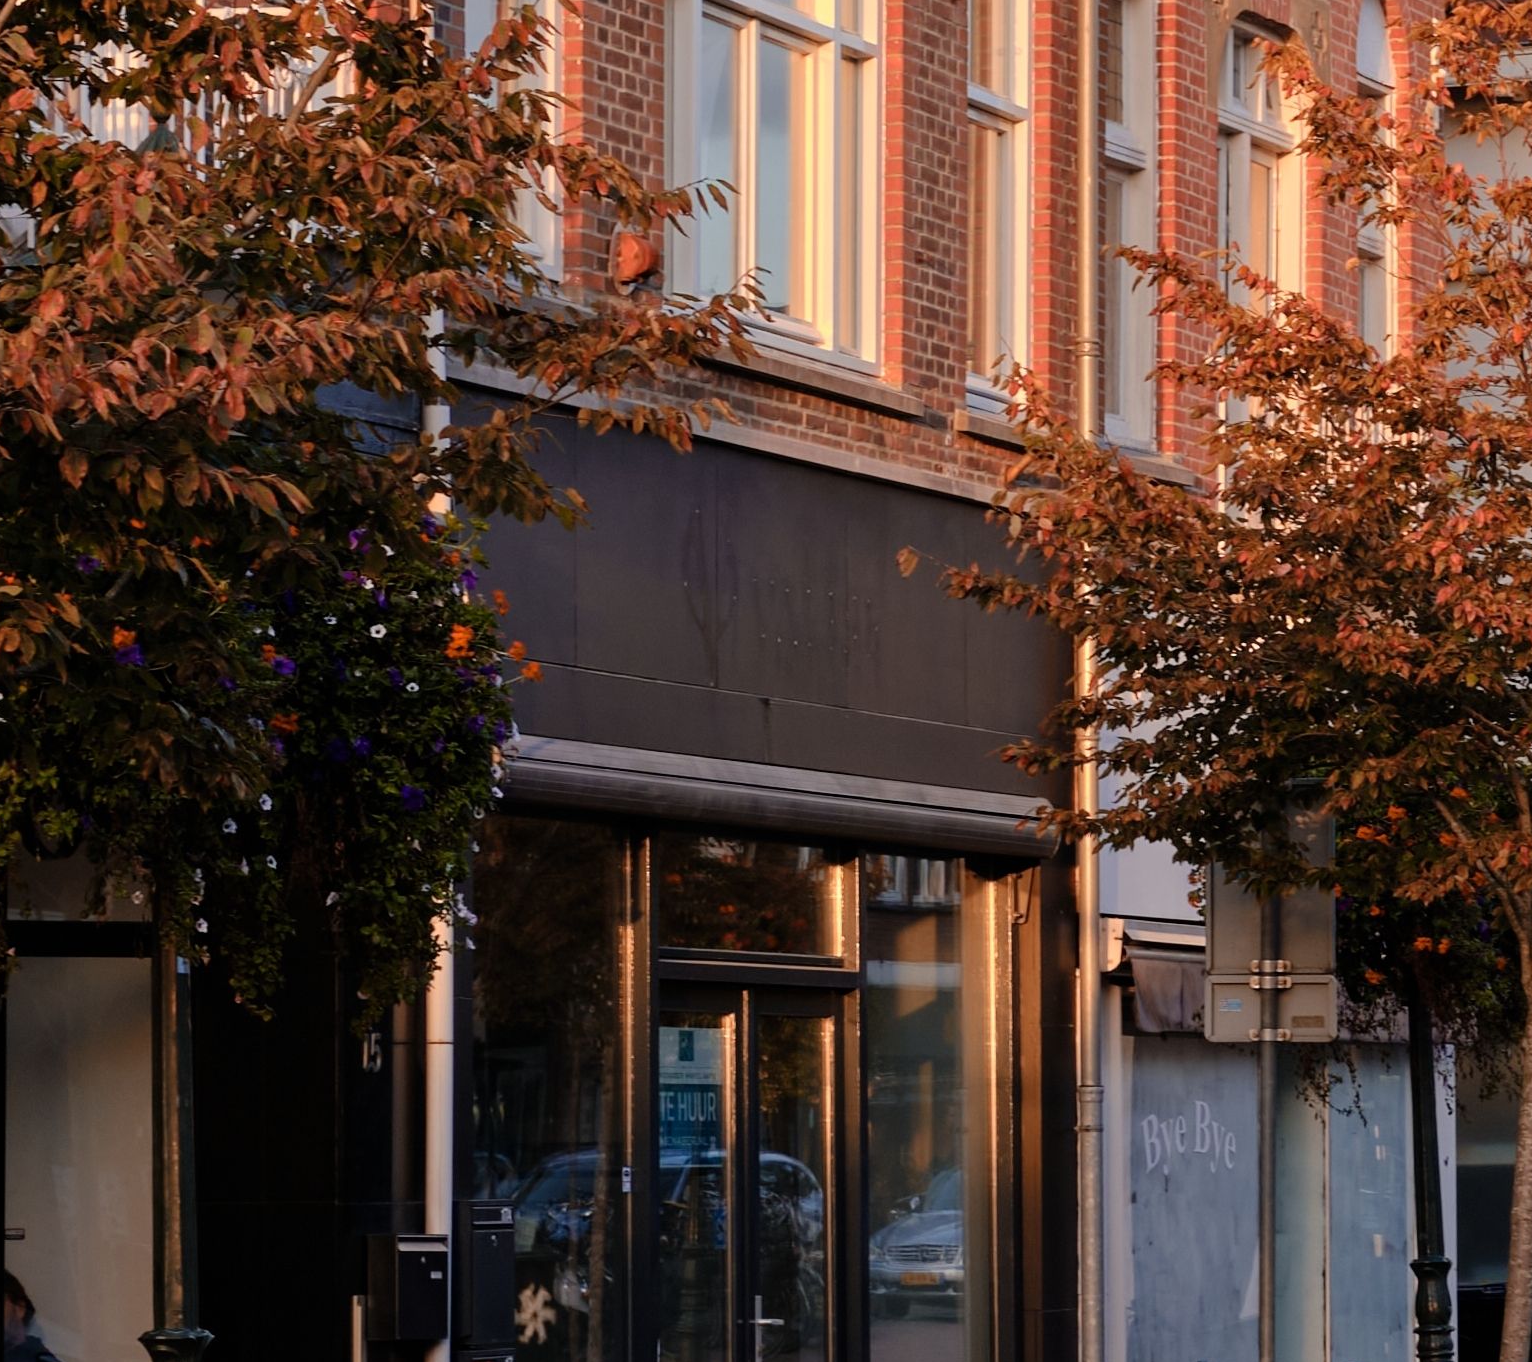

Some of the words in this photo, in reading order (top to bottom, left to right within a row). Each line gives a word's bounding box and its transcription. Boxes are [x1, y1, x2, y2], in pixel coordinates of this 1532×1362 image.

[658, 1091, 676, 1122] TE
[676, 1091, 717, 1122] HUUR
[1140, 1113, 1187, 1177] Bye
[1192, 1099, 1237, 1174] Bye
